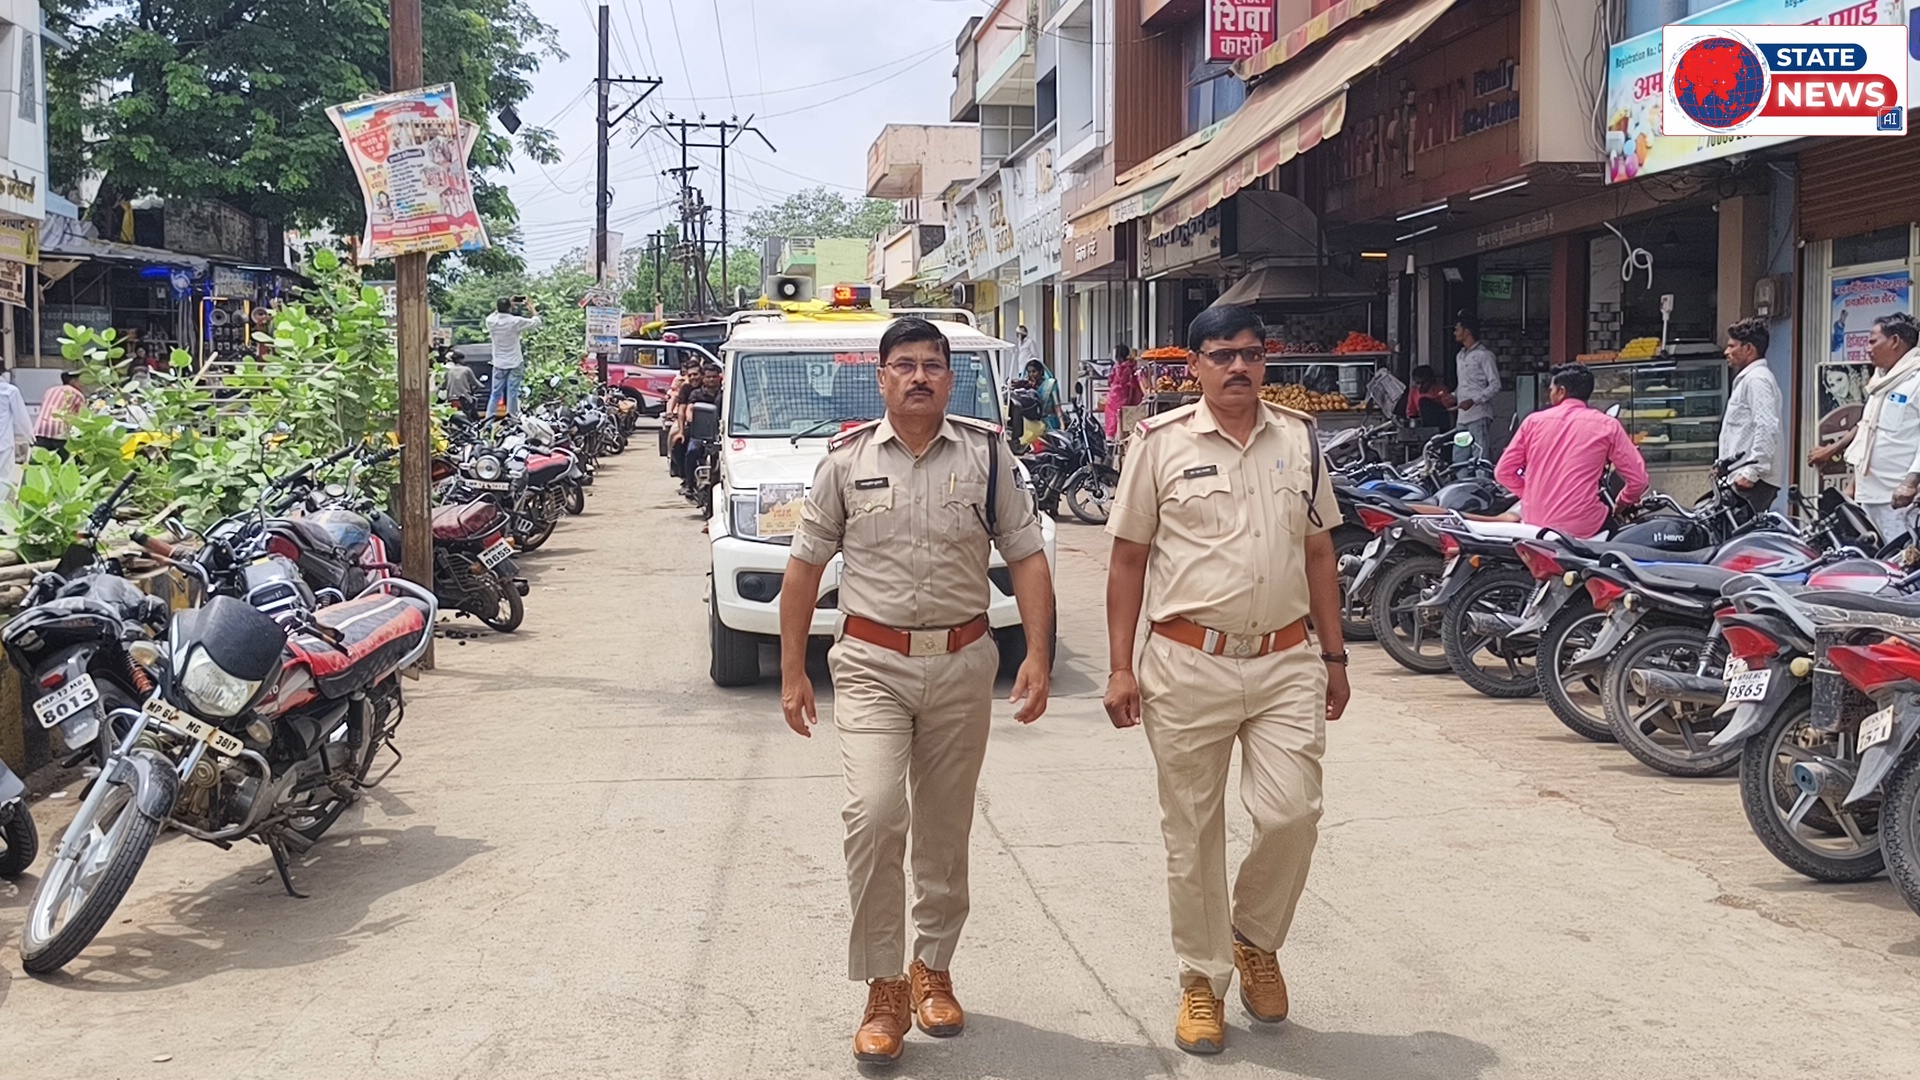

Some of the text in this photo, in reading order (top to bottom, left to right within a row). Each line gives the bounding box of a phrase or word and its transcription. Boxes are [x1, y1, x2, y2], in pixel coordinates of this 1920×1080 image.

[1213, 0, 1271, 32] शिवा
[1219, 32, 1264, 56] काशी
[1615, 50, 1646, 69] Registration
[1633, 71, 1663, 101] अम
[42, 687, 94, 724] 8013
[1729, 683, 1764, 699] 9865
[146, 701, 161, 714] MP
[185, 721, 202, 735] MG
[215, 735, 238, 752] 3817
